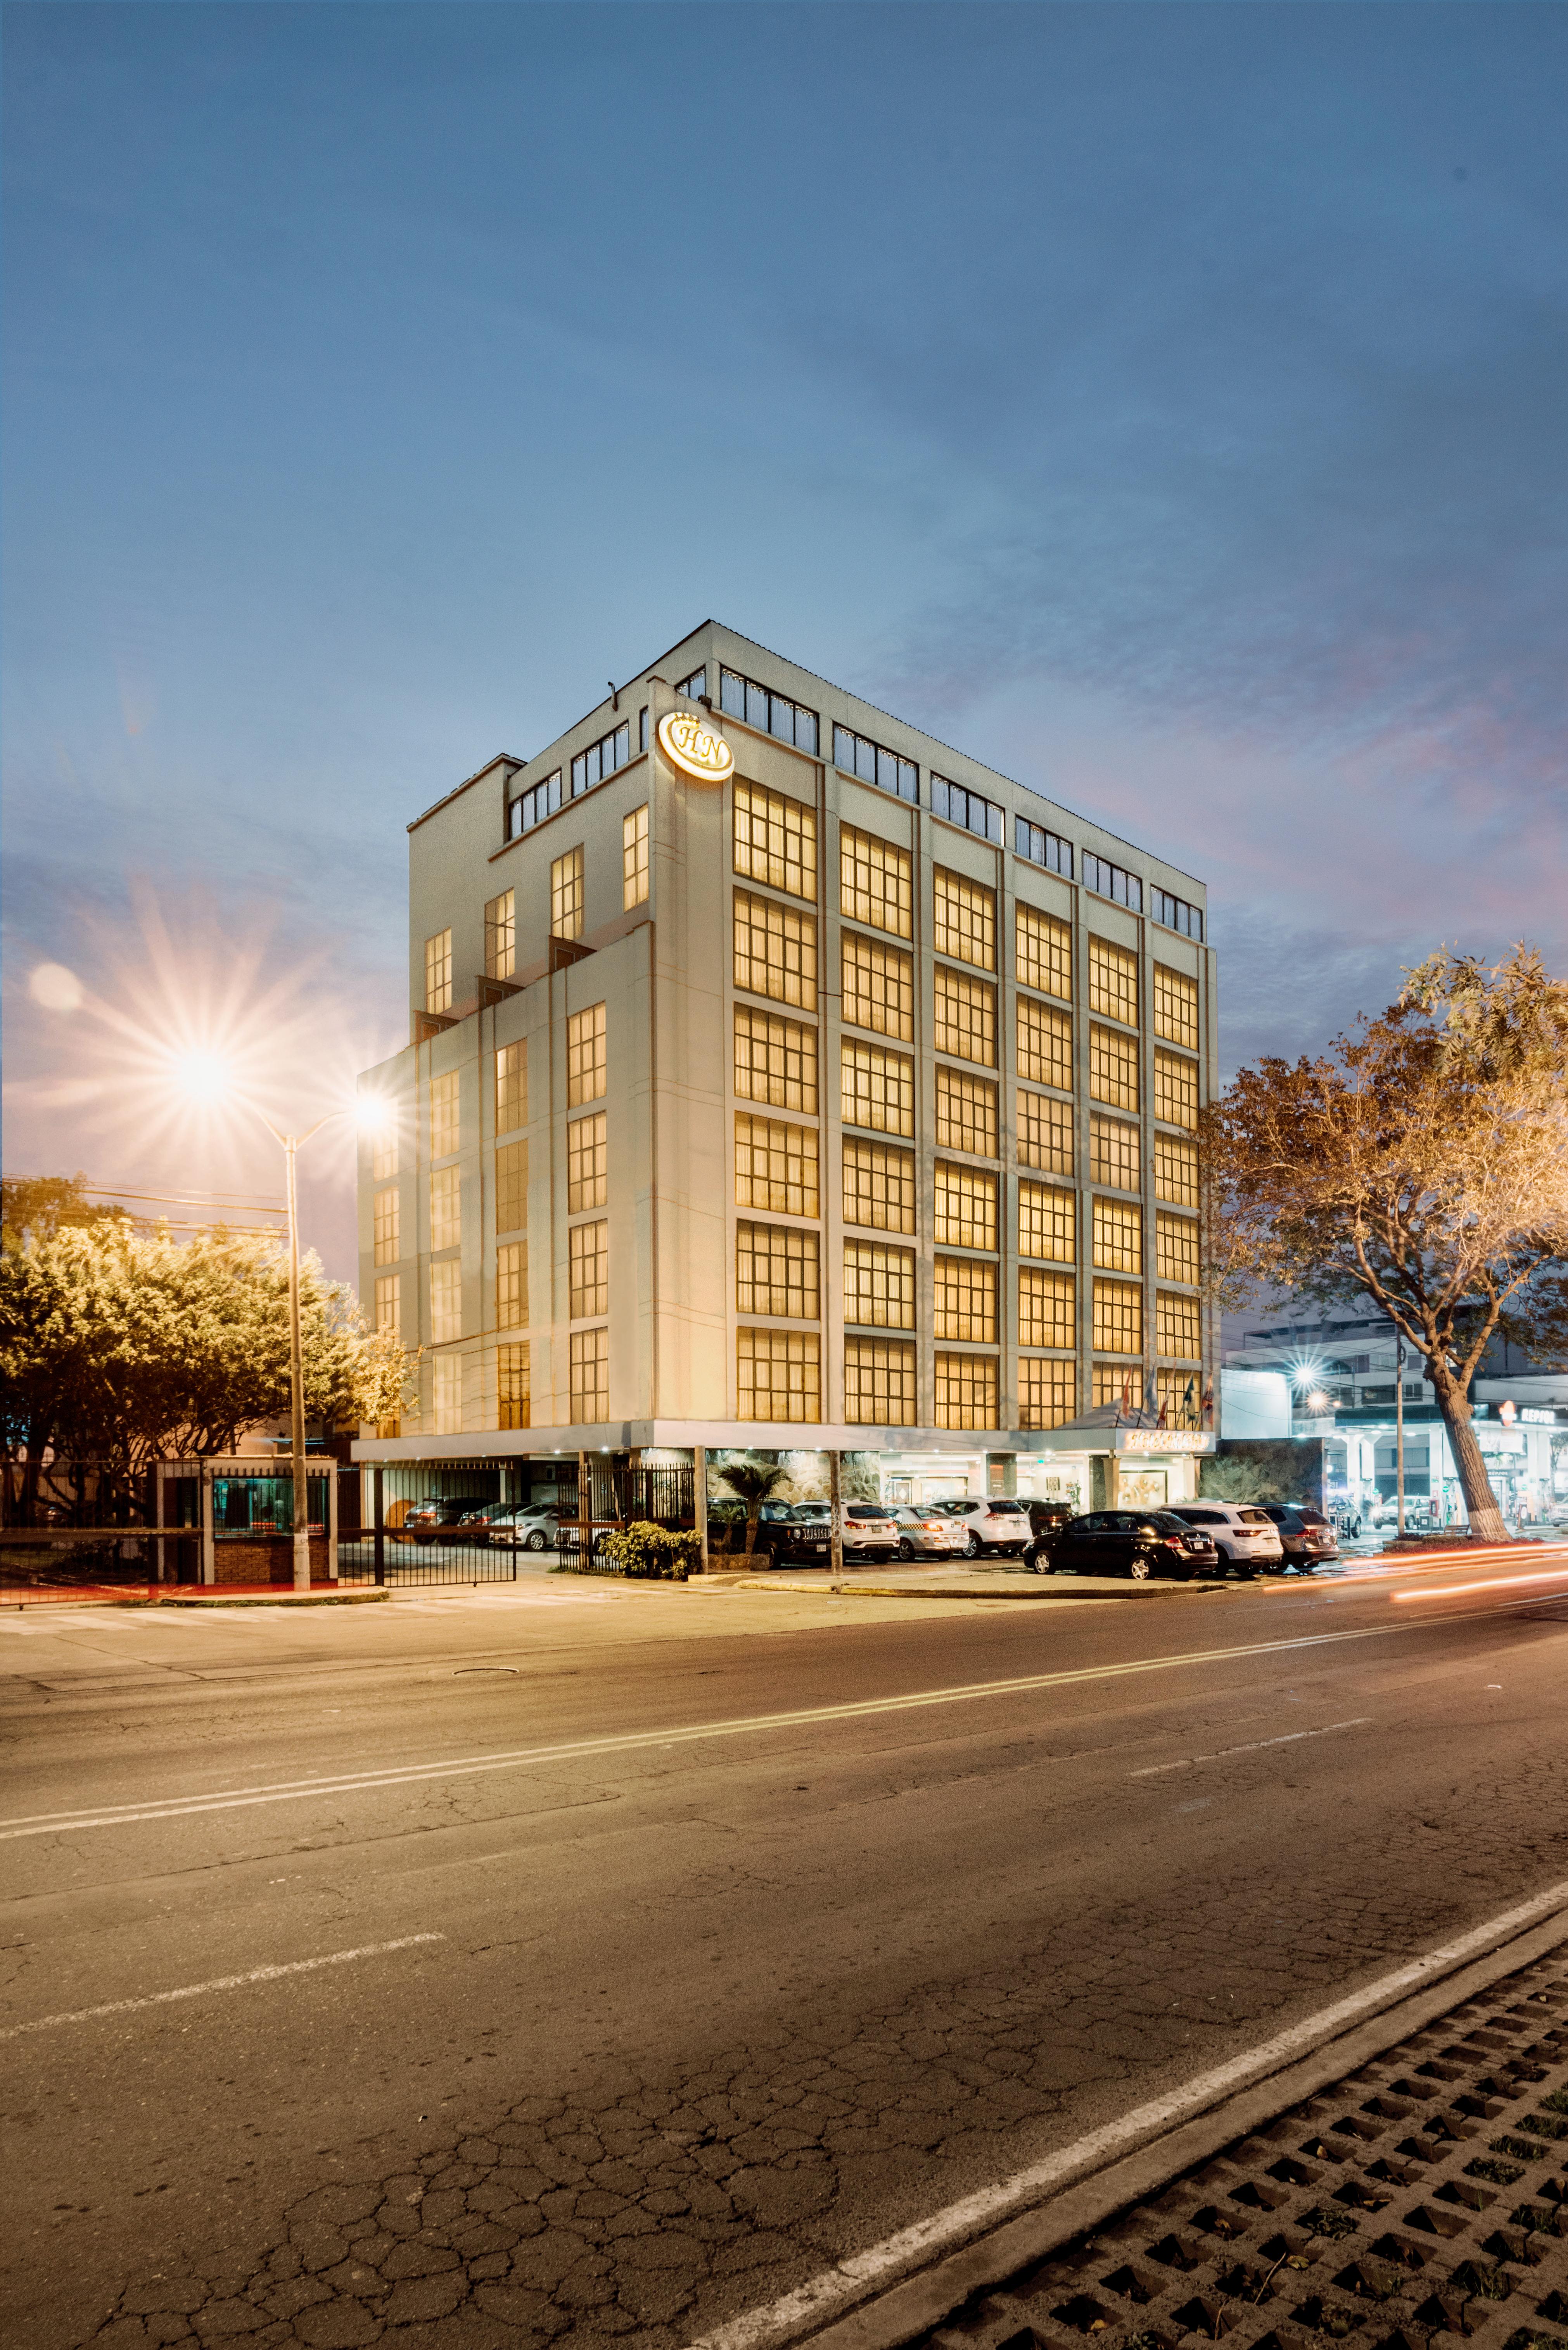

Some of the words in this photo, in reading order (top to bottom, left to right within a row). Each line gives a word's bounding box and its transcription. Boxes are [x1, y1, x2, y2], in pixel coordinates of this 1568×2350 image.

[679, 727, 725, 761] HN
[1521, 1409, 1555, 1424] REPSOL
[1131, 1432, 1165, 1449] Hotel
